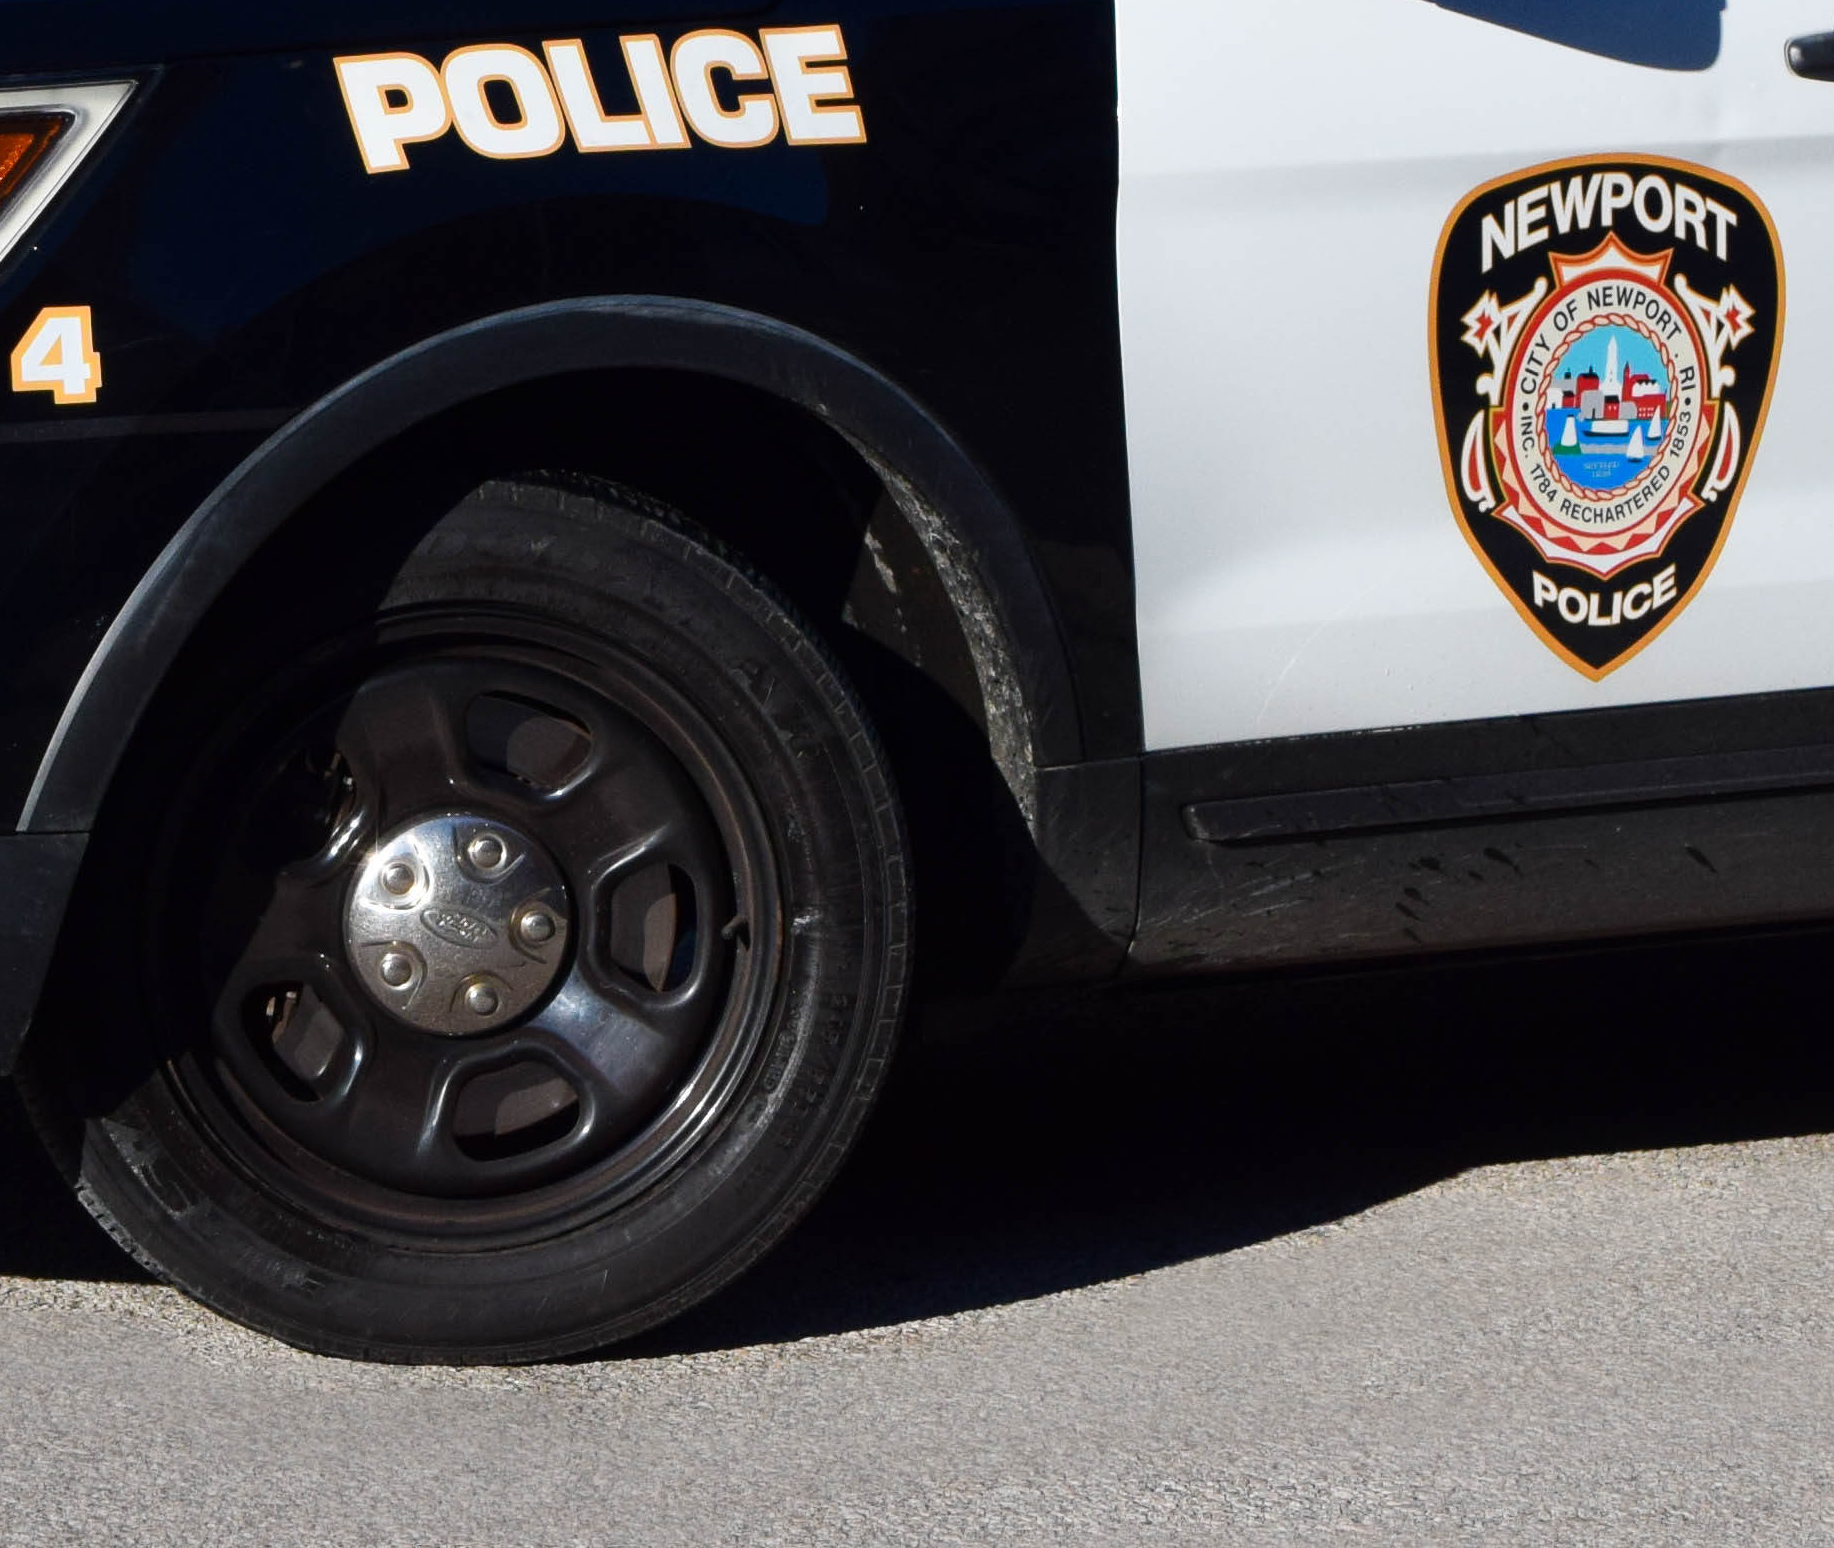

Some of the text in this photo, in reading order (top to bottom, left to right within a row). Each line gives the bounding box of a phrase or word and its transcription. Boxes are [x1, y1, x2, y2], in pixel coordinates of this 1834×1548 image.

[333, 23, 867, 175] POLICE
[1480, 172, 1738, 274] NEWPORT
[10, 305, 103, 404] 4
[1520, 285, 1697, 395] CITY OF NEWPORT RI
[1530, 463, 1559, 503] 1784
[1558, 464, 1671, 525] RECHARTERED
[1670, 410, 1692, 459] 1853
[1531, 562, 1678, 627] POLICE
